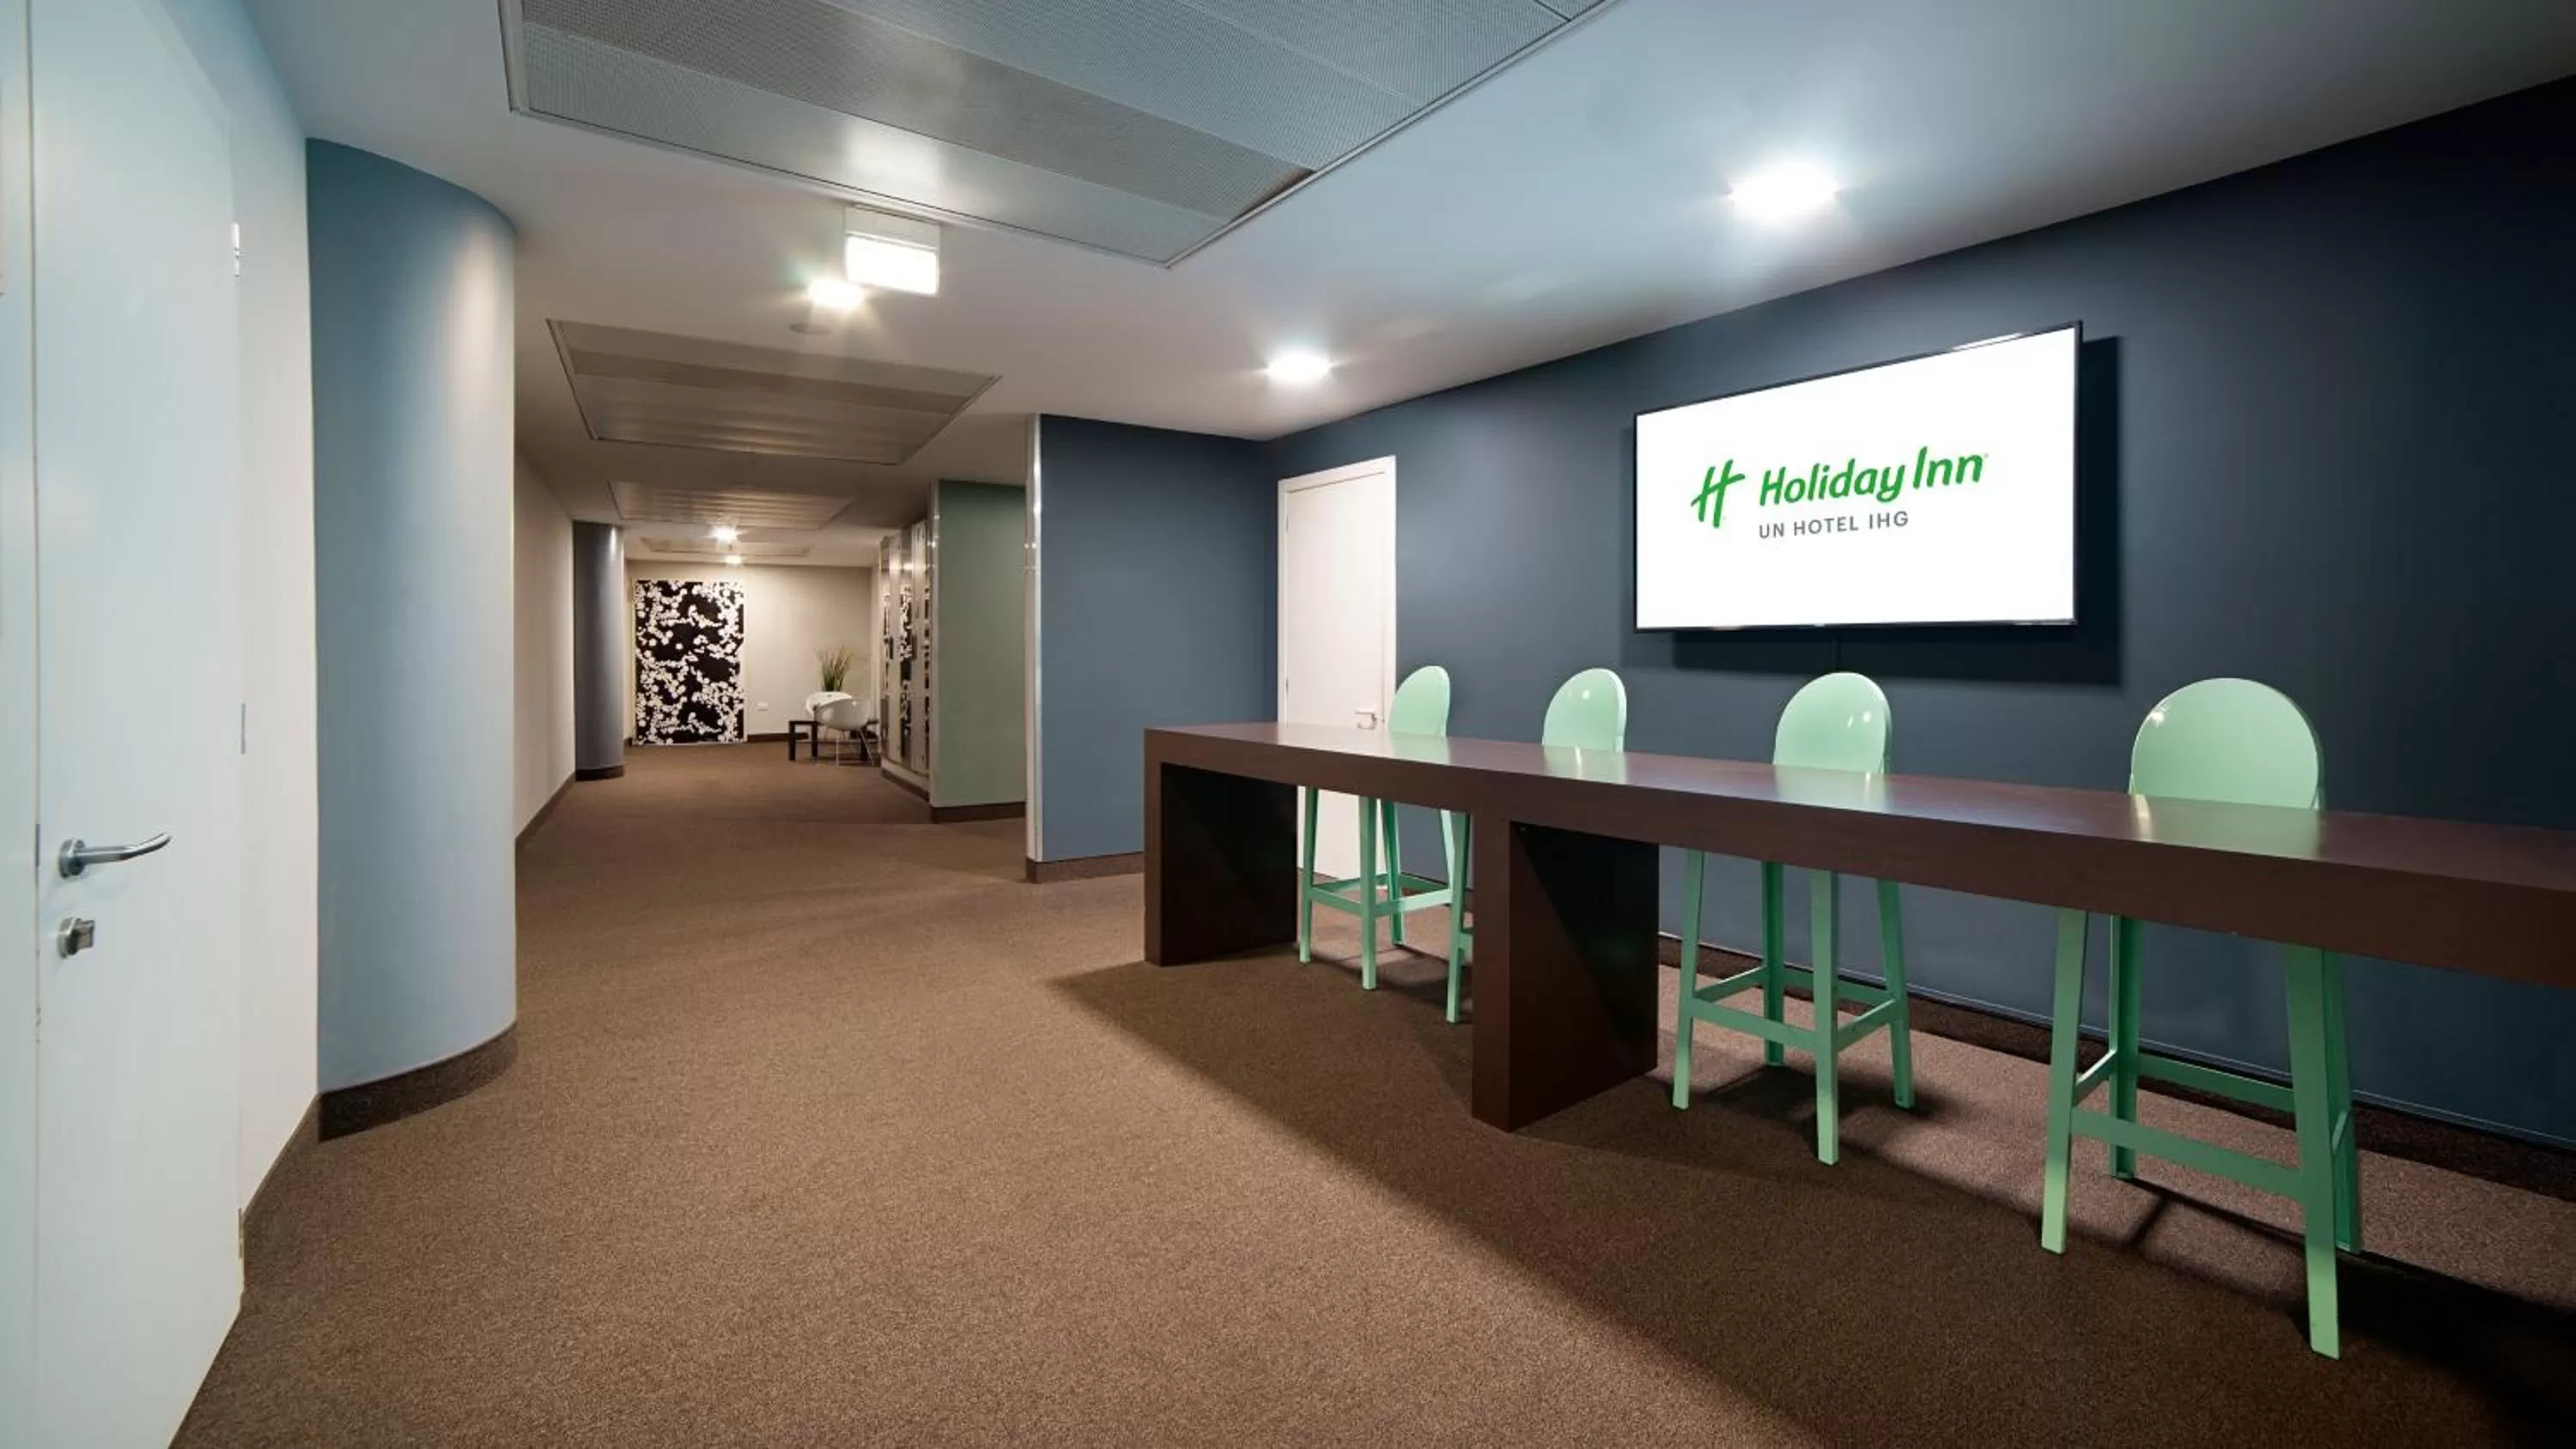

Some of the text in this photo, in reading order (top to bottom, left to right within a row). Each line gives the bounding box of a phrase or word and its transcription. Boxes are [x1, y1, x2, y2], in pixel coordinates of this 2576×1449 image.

[1759, 446, 1985, 507] Holiday Inn
[1759, 510, 1909, 539] UN HOTEL IHG
